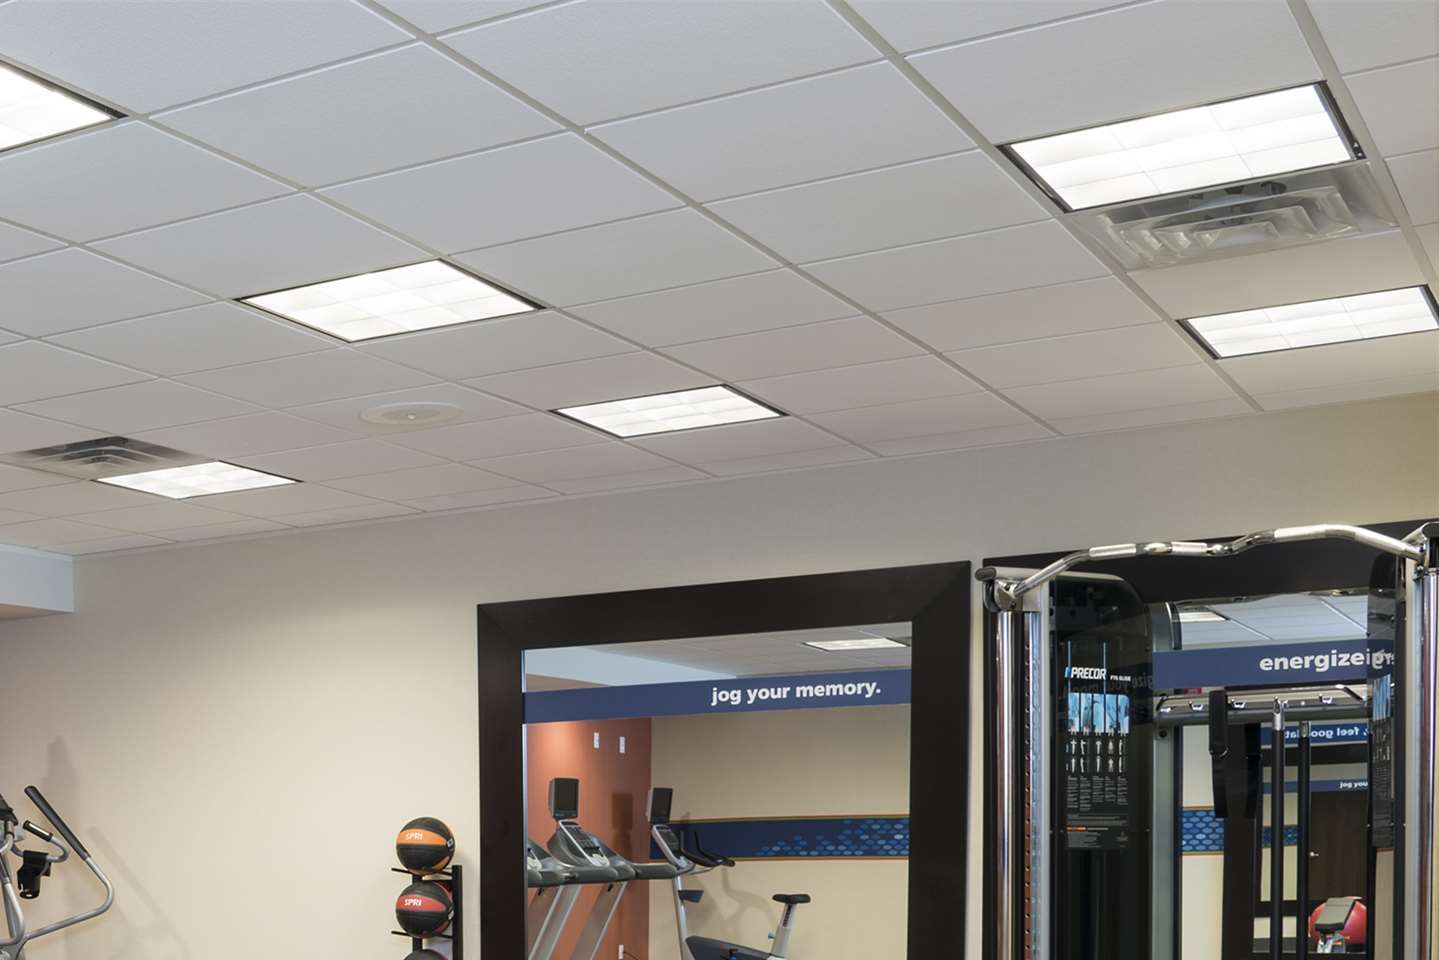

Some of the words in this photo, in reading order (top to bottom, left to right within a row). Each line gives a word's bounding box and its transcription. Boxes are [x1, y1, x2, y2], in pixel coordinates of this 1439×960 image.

[1259, 649, 1365, 672] energize
[1070, 666, 1107, 680] PRECOR
[711, 687, 742, 706] jog
[747, 686, 791, 704] your
[795, 682, 881, 698] memory.
[405, 832, 423, 840] SPRI
[404, 898, 422, 906] SPRI
